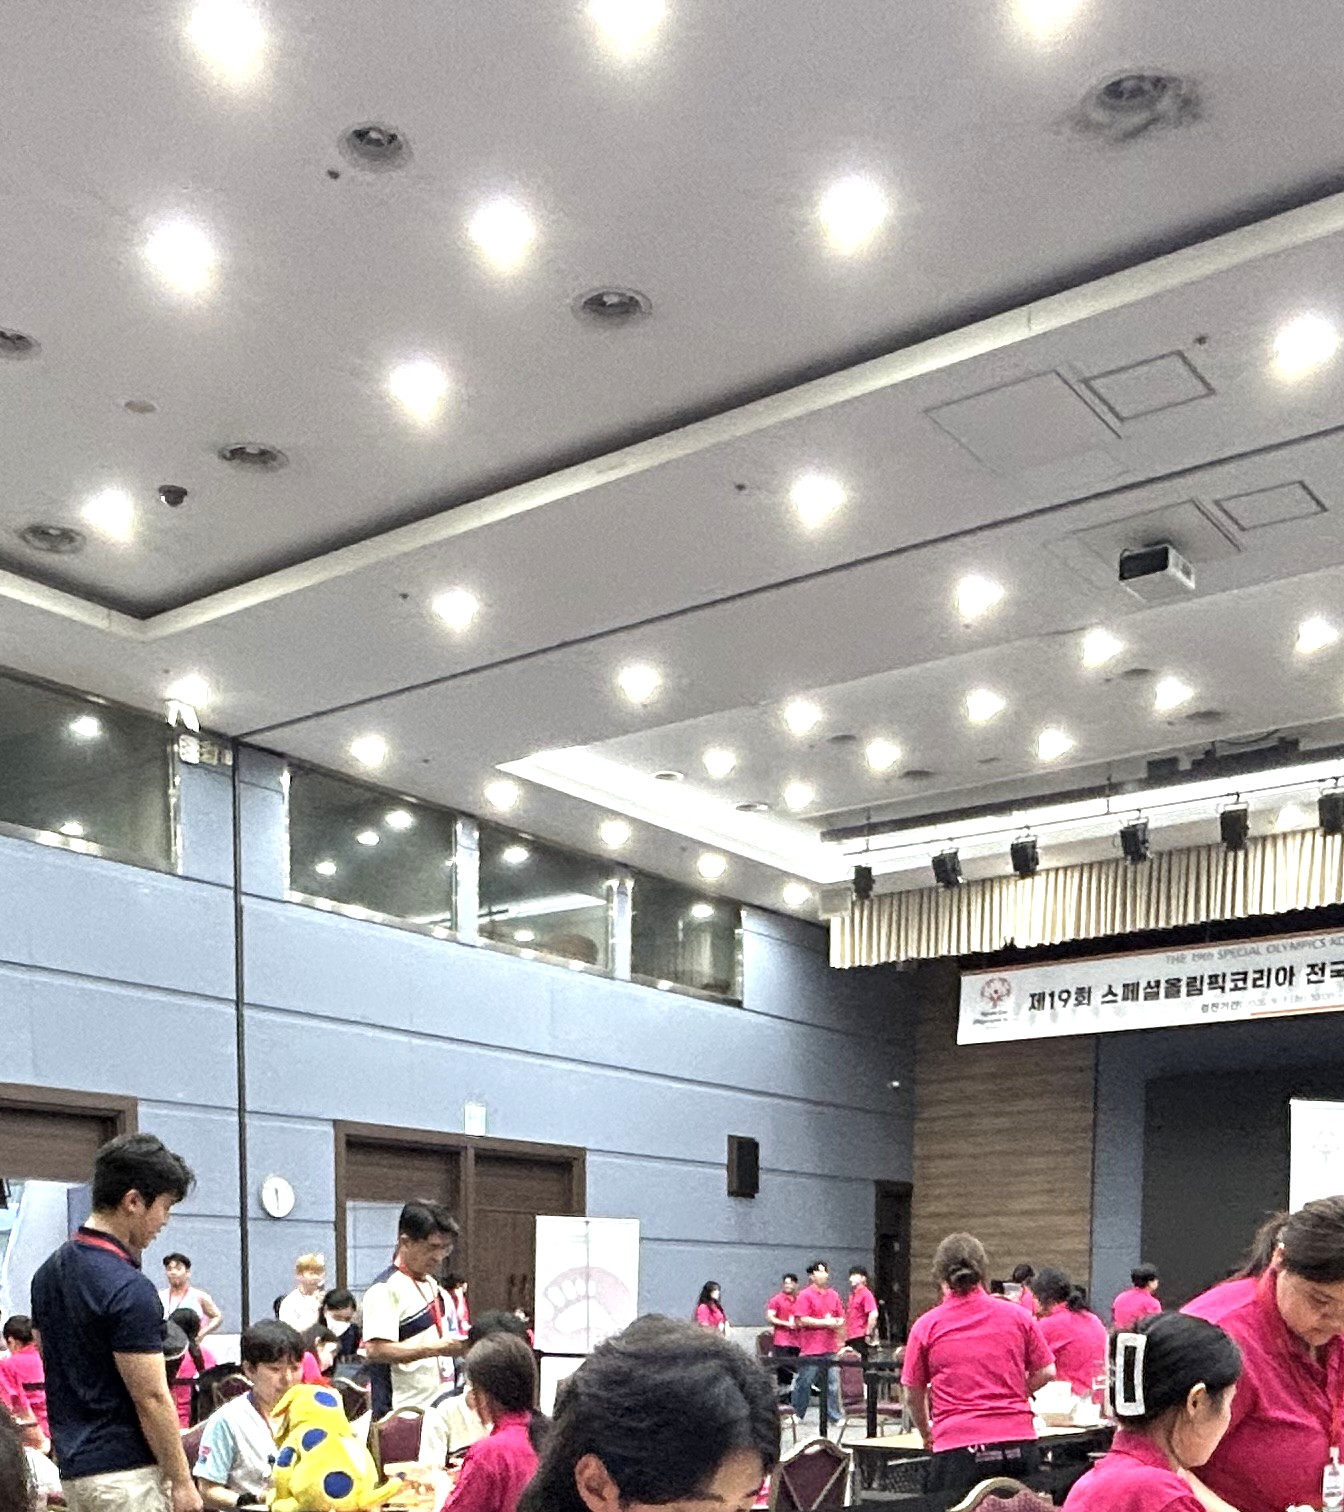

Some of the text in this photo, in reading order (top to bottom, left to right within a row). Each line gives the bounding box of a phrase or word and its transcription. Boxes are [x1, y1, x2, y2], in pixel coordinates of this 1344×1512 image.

[1217, 947, 1261, 960] SPECIAL
[1266, 938, 1327, 954] OLYMPICS
[1028, 985, 1093, 1012] 제19회
